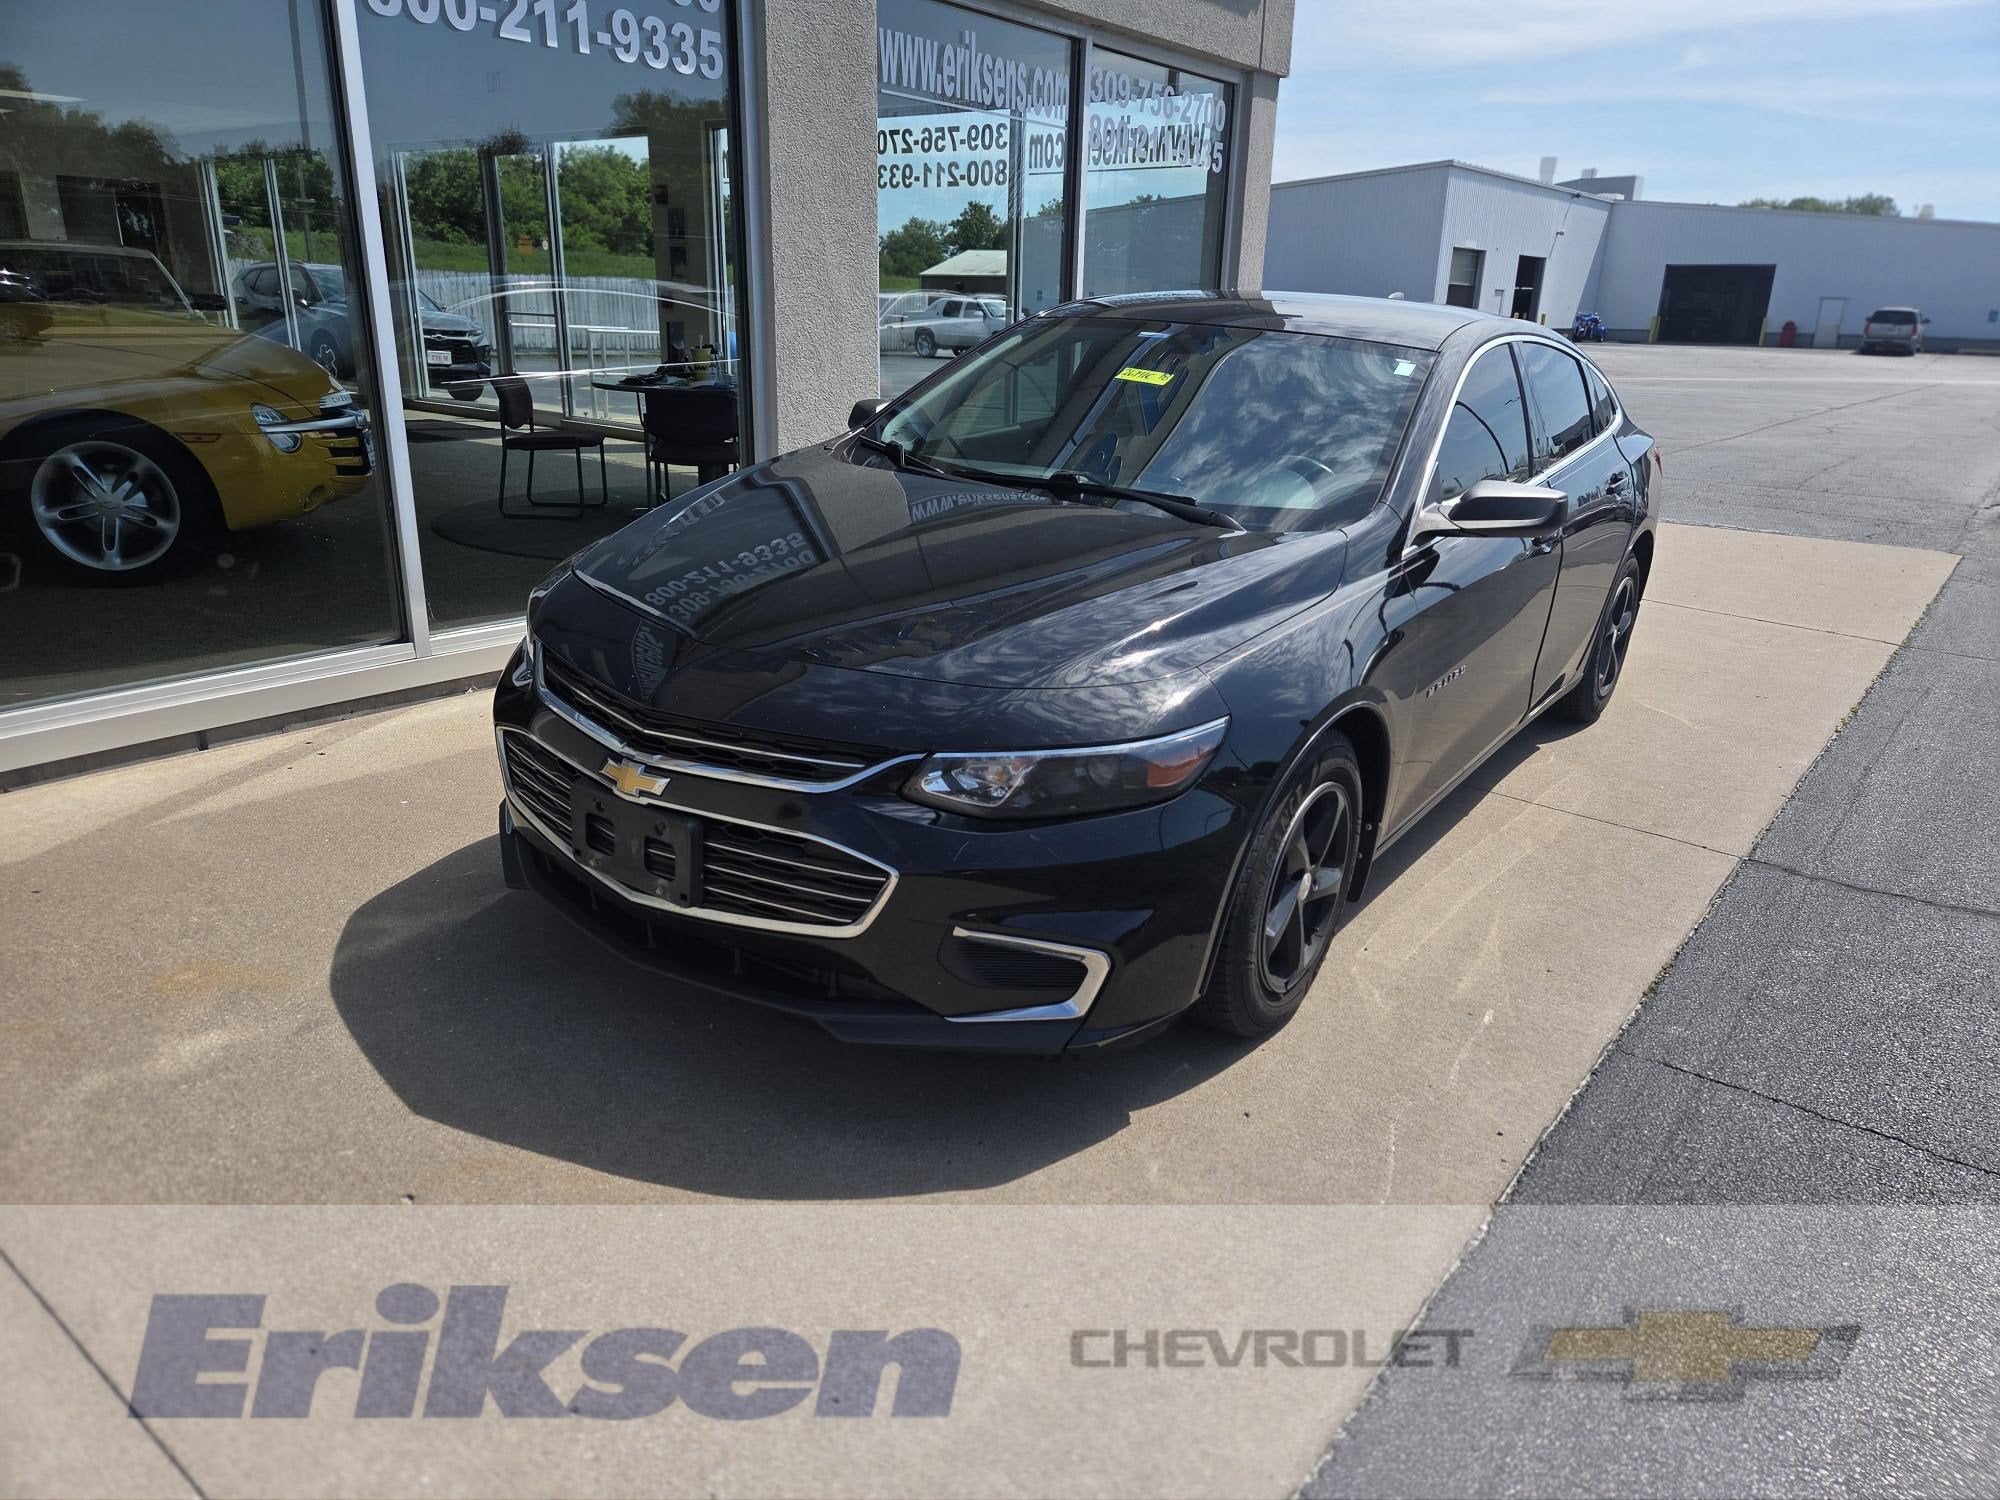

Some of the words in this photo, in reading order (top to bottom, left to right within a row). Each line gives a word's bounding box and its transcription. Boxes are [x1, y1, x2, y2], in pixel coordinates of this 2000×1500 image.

[367, 0, 724, 80] 0-211-9335
[879, 27, 1070, 120] www.eriksens.com
[1090, 64, 1226, 132] 309-756-2700
